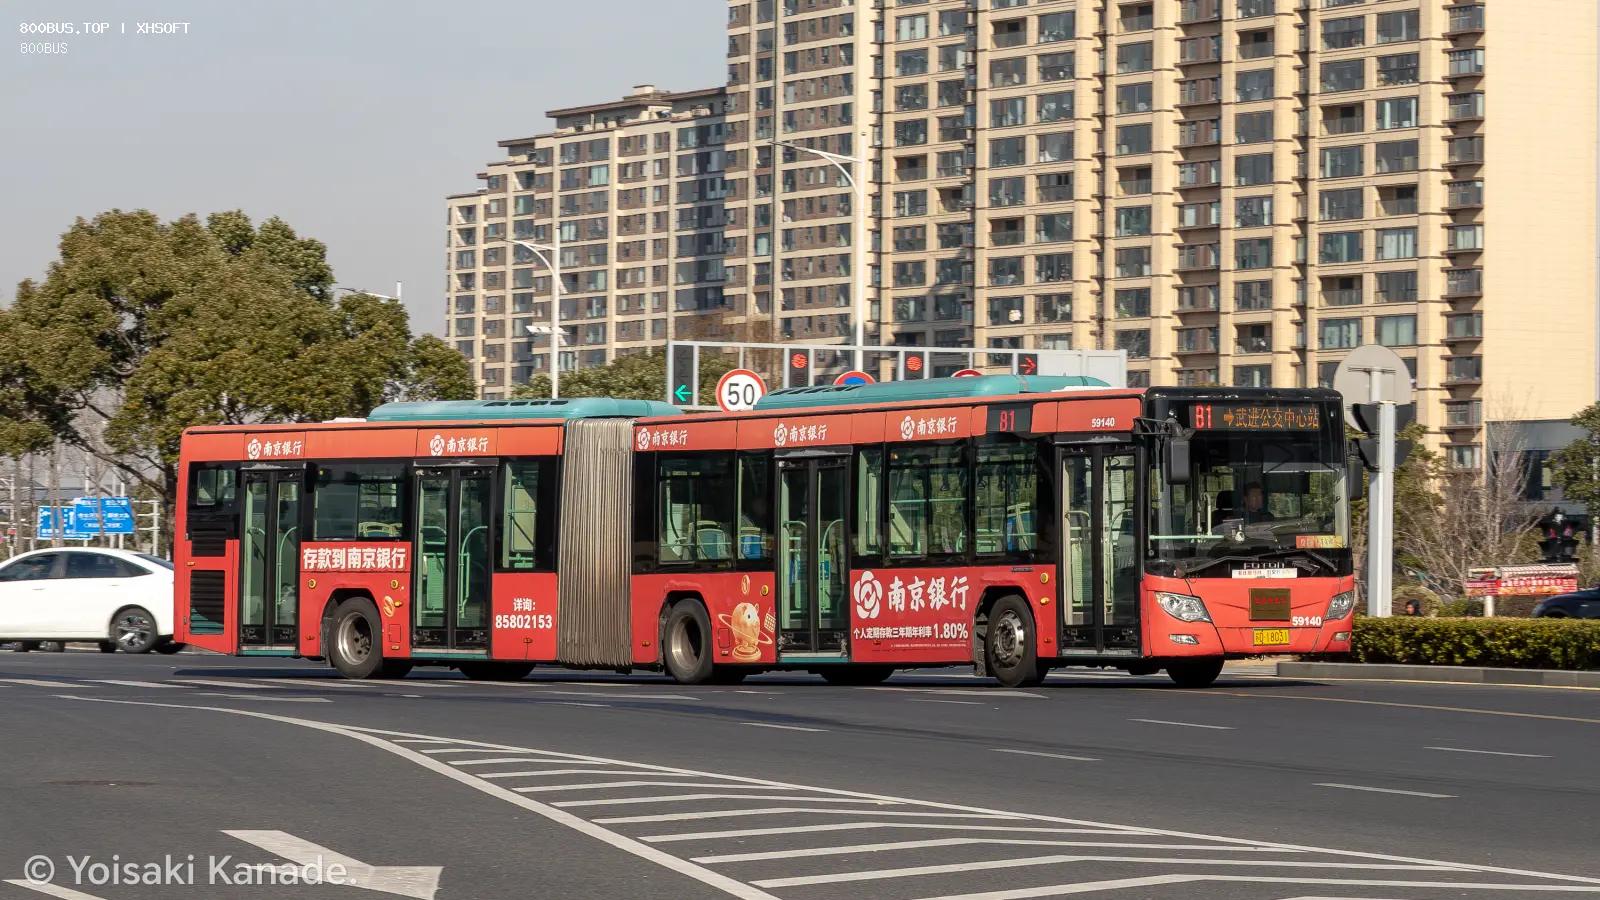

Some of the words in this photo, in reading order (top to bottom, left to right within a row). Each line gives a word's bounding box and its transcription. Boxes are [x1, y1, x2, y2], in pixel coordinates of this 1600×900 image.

[728, 383, 755, 406] 50
[917, 416, 958, 434] 南京银行
[1091, 417, 1116, 428] 59140
[1195, 405, 1212, 429] B1
[1235, 407, 1320, 429] 武进公交中心站
[652, 429, 688, 446] 南京银行
[789, 423, 828, 441] 南京银行
[263, 440, 302, 457] 南京银行
[446, 436, 489, 453] 南京银行
[303, 547, 406, 570] 存款到南京银行
[888, 575, 970, 613] 南京银行
[495, 615, 553, 629] 85802153
[1291, 616, 1322, 626] 59140
[853, 626, 932, 640] 个人定期存款三年期年利率
[933, 622, 969, 639] 1.80%
